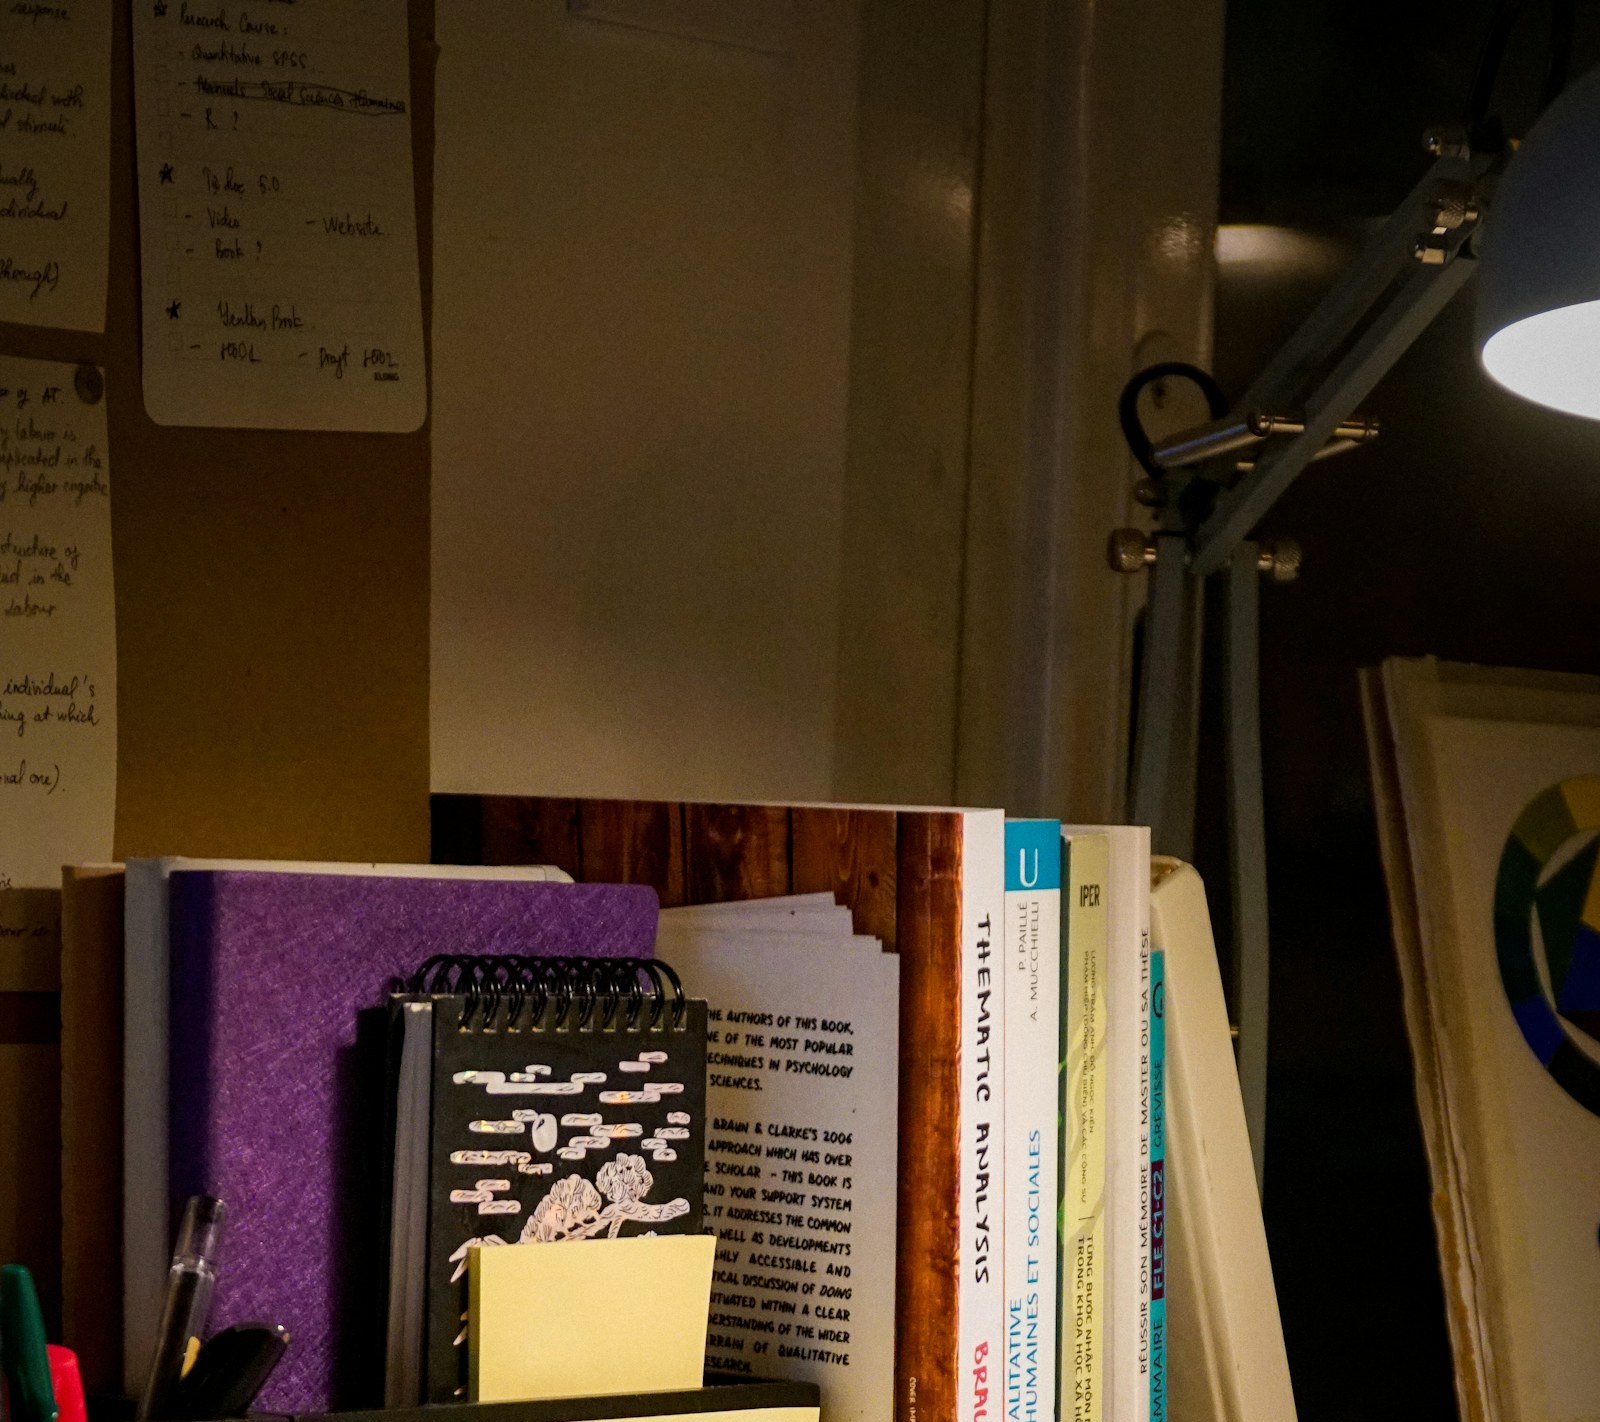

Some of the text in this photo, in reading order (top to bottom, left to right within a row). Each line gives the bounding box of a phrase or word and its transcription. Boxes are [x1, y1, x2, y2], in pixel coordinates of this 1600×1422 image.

[1020, 848, 1038, 887] U
[1017, 903, 1028, 953] PAILLÉ
[1029, 902, 1039, 1001] MUCCHIELLI
[1138, 927, 1149, 987] THÈSE
[1141, 988, 1148, 1012] SA
[727, 1010, 773, 1026] AUTHORS
[778, 1016, 791, 1028] OF
[796, 1017, 817, 1031] THIS
[821, 1020, 854, 1035] BOOK,
[1140, 1019, 1148, 1047] OU
[725, 1032, 853, 1056] OF THE MOST POPULAR
[710, 1074, 763, 1090] SCIENCES.
[769, 1059, 780, 1070] IN
[786, 1060, 853, 1078] PSYCHOLOGY
[975, 913, 991, 1284] THEMATIC ANALYSIS
[1153, 1057, 1163, 1148] GREVISSE
[713, 1118, 853, 1143] BRAUN & CLARKE'S 2006
[708, 1140, 852, 1167] APPROACH WHICH HAS OVER
[1140, 1133, 1148, 1156] DE
[716, 1163, 852, 1189] SCHOLAR THIS BOOK IS
[1027, 1129, 1041, 1247] SOCIALES
[703, 1183, 851, 1211] AND YOUR SUPPORT SYSTEM
[1139, 1163, 1148, 1248] MÉMOIRE
[727, 1207, 782, 1225] ADDRESSES
[786, 1215, 804, 1227] THE
[808, 1217, 851, 1234] COMMON
[1153, 1168, 1164, 1291] FLE C1-C2
[720, 1228, 851, 1255] WELL AS DEVELOPMENTS
[750, 1253, 851, 1277] ACCESSIBLE AND
[1027, 1255, 1039, 1284] ET
[1077, 1236, 1085, 1290] TRONG
[1140, 1255, 1148, 1295] SON
[743, 1274, 798, 1292] DISCUSSION
[802, 1283, 815, 1295] OF
[820, 1285, 852, 1299] DOING
[762, 1300, 850, 1322] WITHIN A CLEAR
[1076, 1295, 1084, 1339] KHOA
[778, 1323, 850, 1344] OF THE WIDER
[1139, 1301, 1148, 1374] RÉUSSIR
[754, 1342, 849, 1366] OF QUALITATIVE
[908, 1377, 916, 1403] COVER
